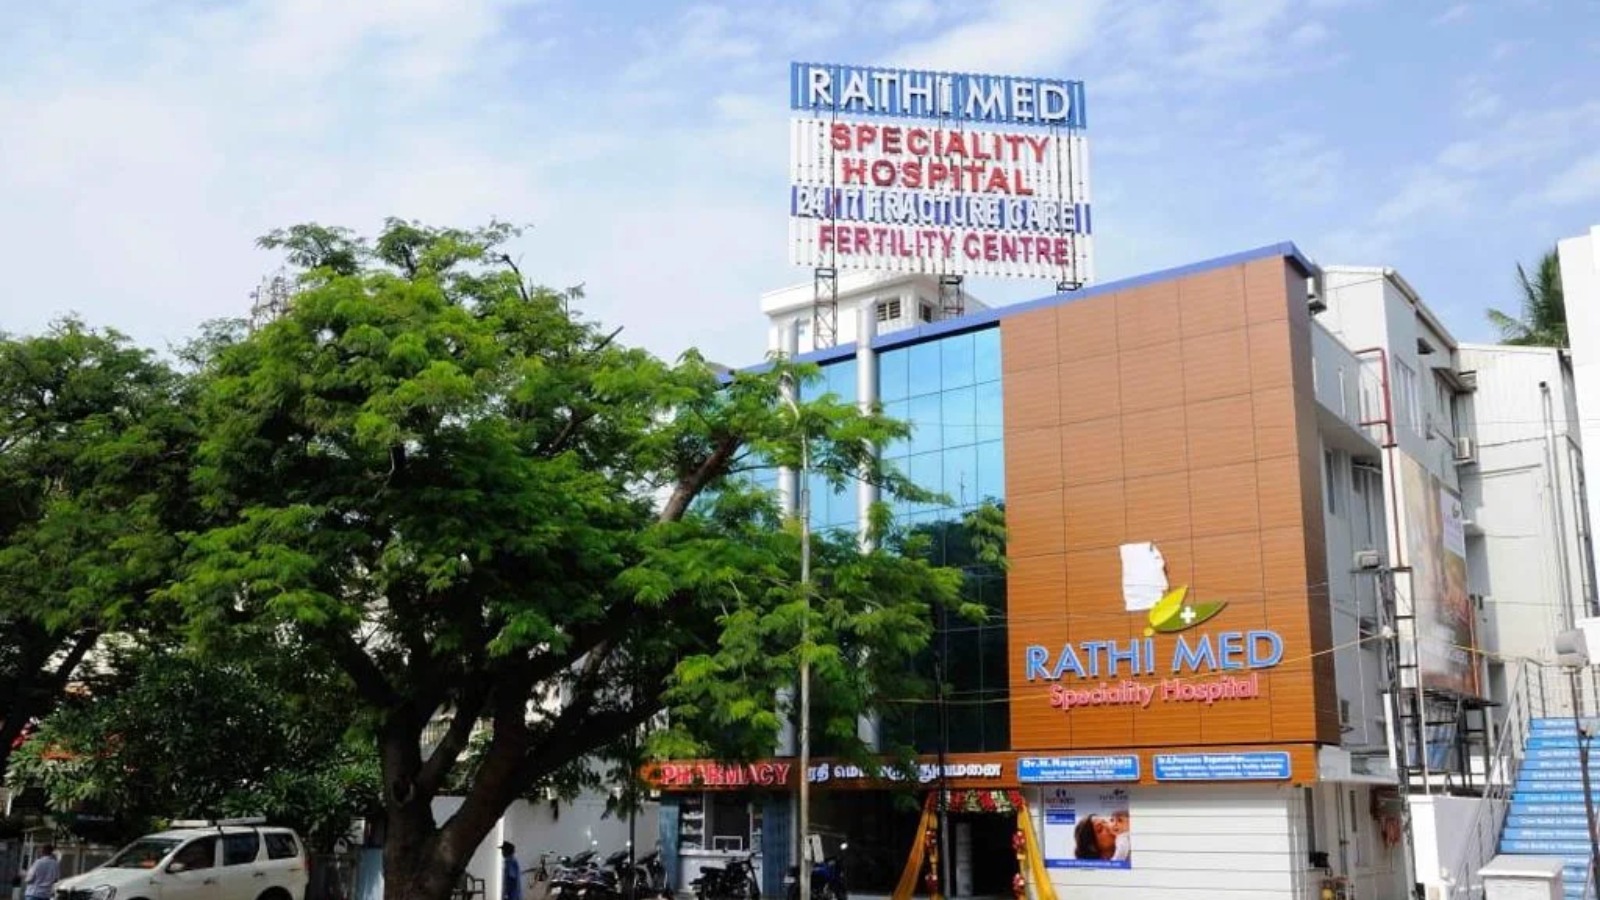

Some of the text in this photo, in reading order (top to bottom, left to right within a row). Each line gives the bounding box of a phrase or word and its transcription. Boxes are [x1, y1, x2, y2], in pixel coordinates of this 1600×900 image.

[808, 67, 1070, 122] RATHI MED
[830, 123, 1050, 163] SPECIALITY
[842, 157, 1034, 196] HOSPITAL
[869, 191, 1004, 229] FRACTURE
[1008, 199, 1075, 234] CARE
[819, 225, 1070, 266] FERTILITY CENTRE
[1026, 630, 1285, 681] RATHI MED
[1050, 674, 1259, 711] Speciality Hospital
